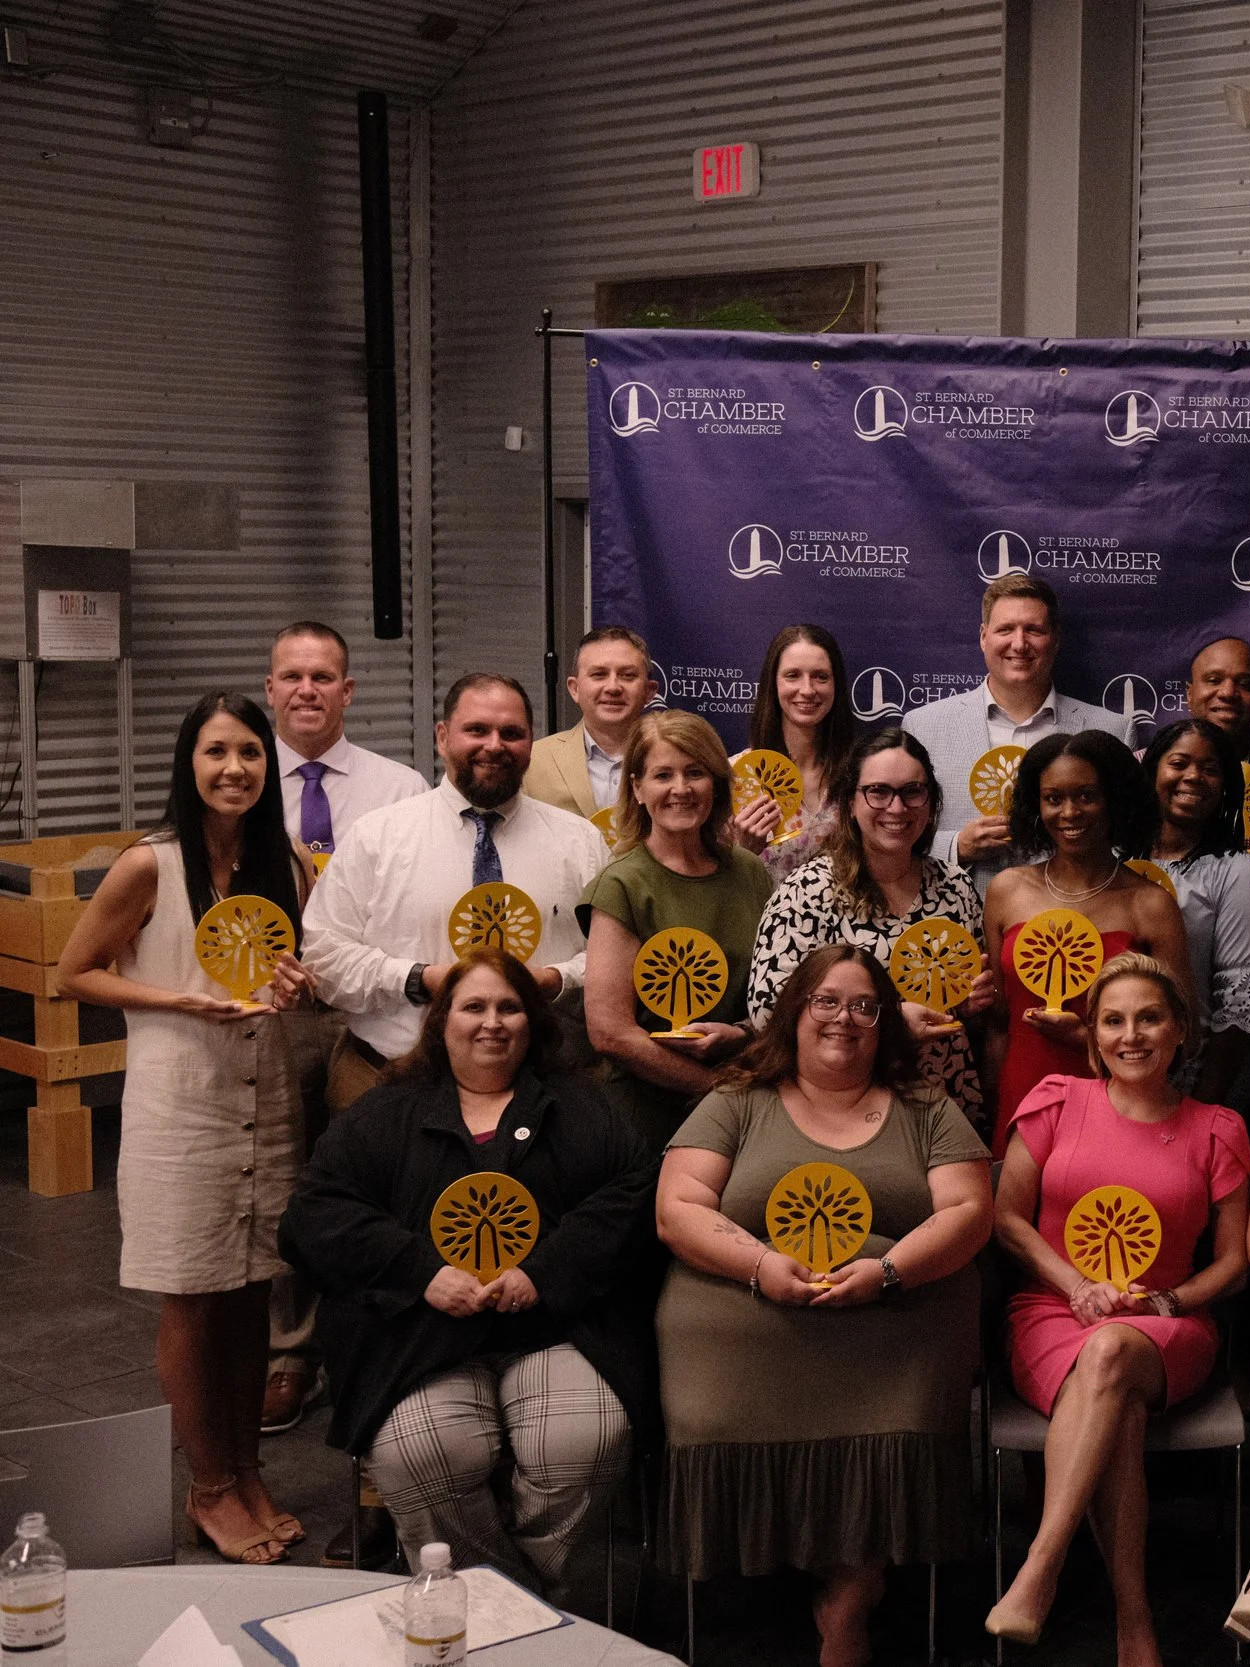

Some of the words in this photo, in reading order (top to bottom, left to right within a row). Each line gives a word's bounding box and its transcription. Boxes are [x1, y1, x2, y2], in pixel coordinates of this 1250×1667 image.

[702, 144, 744, 196] EXIT
[668, 388, 684, 399] ST.
[687, 388, 746, 399] BERNARD
[915, 392, 932, 402] ST.
[935, 392, 994, 403] BERNARD
[1168, 396, 1186, 407] ST.
[1188, 397, 1250, 407] BERNARD
[664, 401, 786, 421] CHAMBER
[911, 405, 1036, 426] CHAMBER
[697, 423, 709, 434] of
[711, 424, 782, 435] COMMERCE
[945, 428, 957, 439] of
[959, 428, 1031, 440] COMMERCE
[1198, 432, 1211, 443] of
[790, 530, 807, 541] ST.
[809, 531, 868, 542] BERNARD
[1038, 537, 1056, 547] ST.
[1058, 537, 1120, 548] BERNARD
[786, 544, 910, 564] CHAMBER
[1035, 550, 1162, 571] CHAMBER
[819, 566, 832, 577] of
[832, 567, 906, 578] COMMERCE
[1069, 572, 1082, 583] of
[1082, 573, 1157, 585] COMMERCE
[671, 666, 685, 676] ST.
[687, 667, 743, 679] BERNARD
[912, 673, 929, 684] ST.
[932, 674, 988, 685] BERNAR
[697, 701, 708, 712] of
[709, 702, 755, 713] COMME
